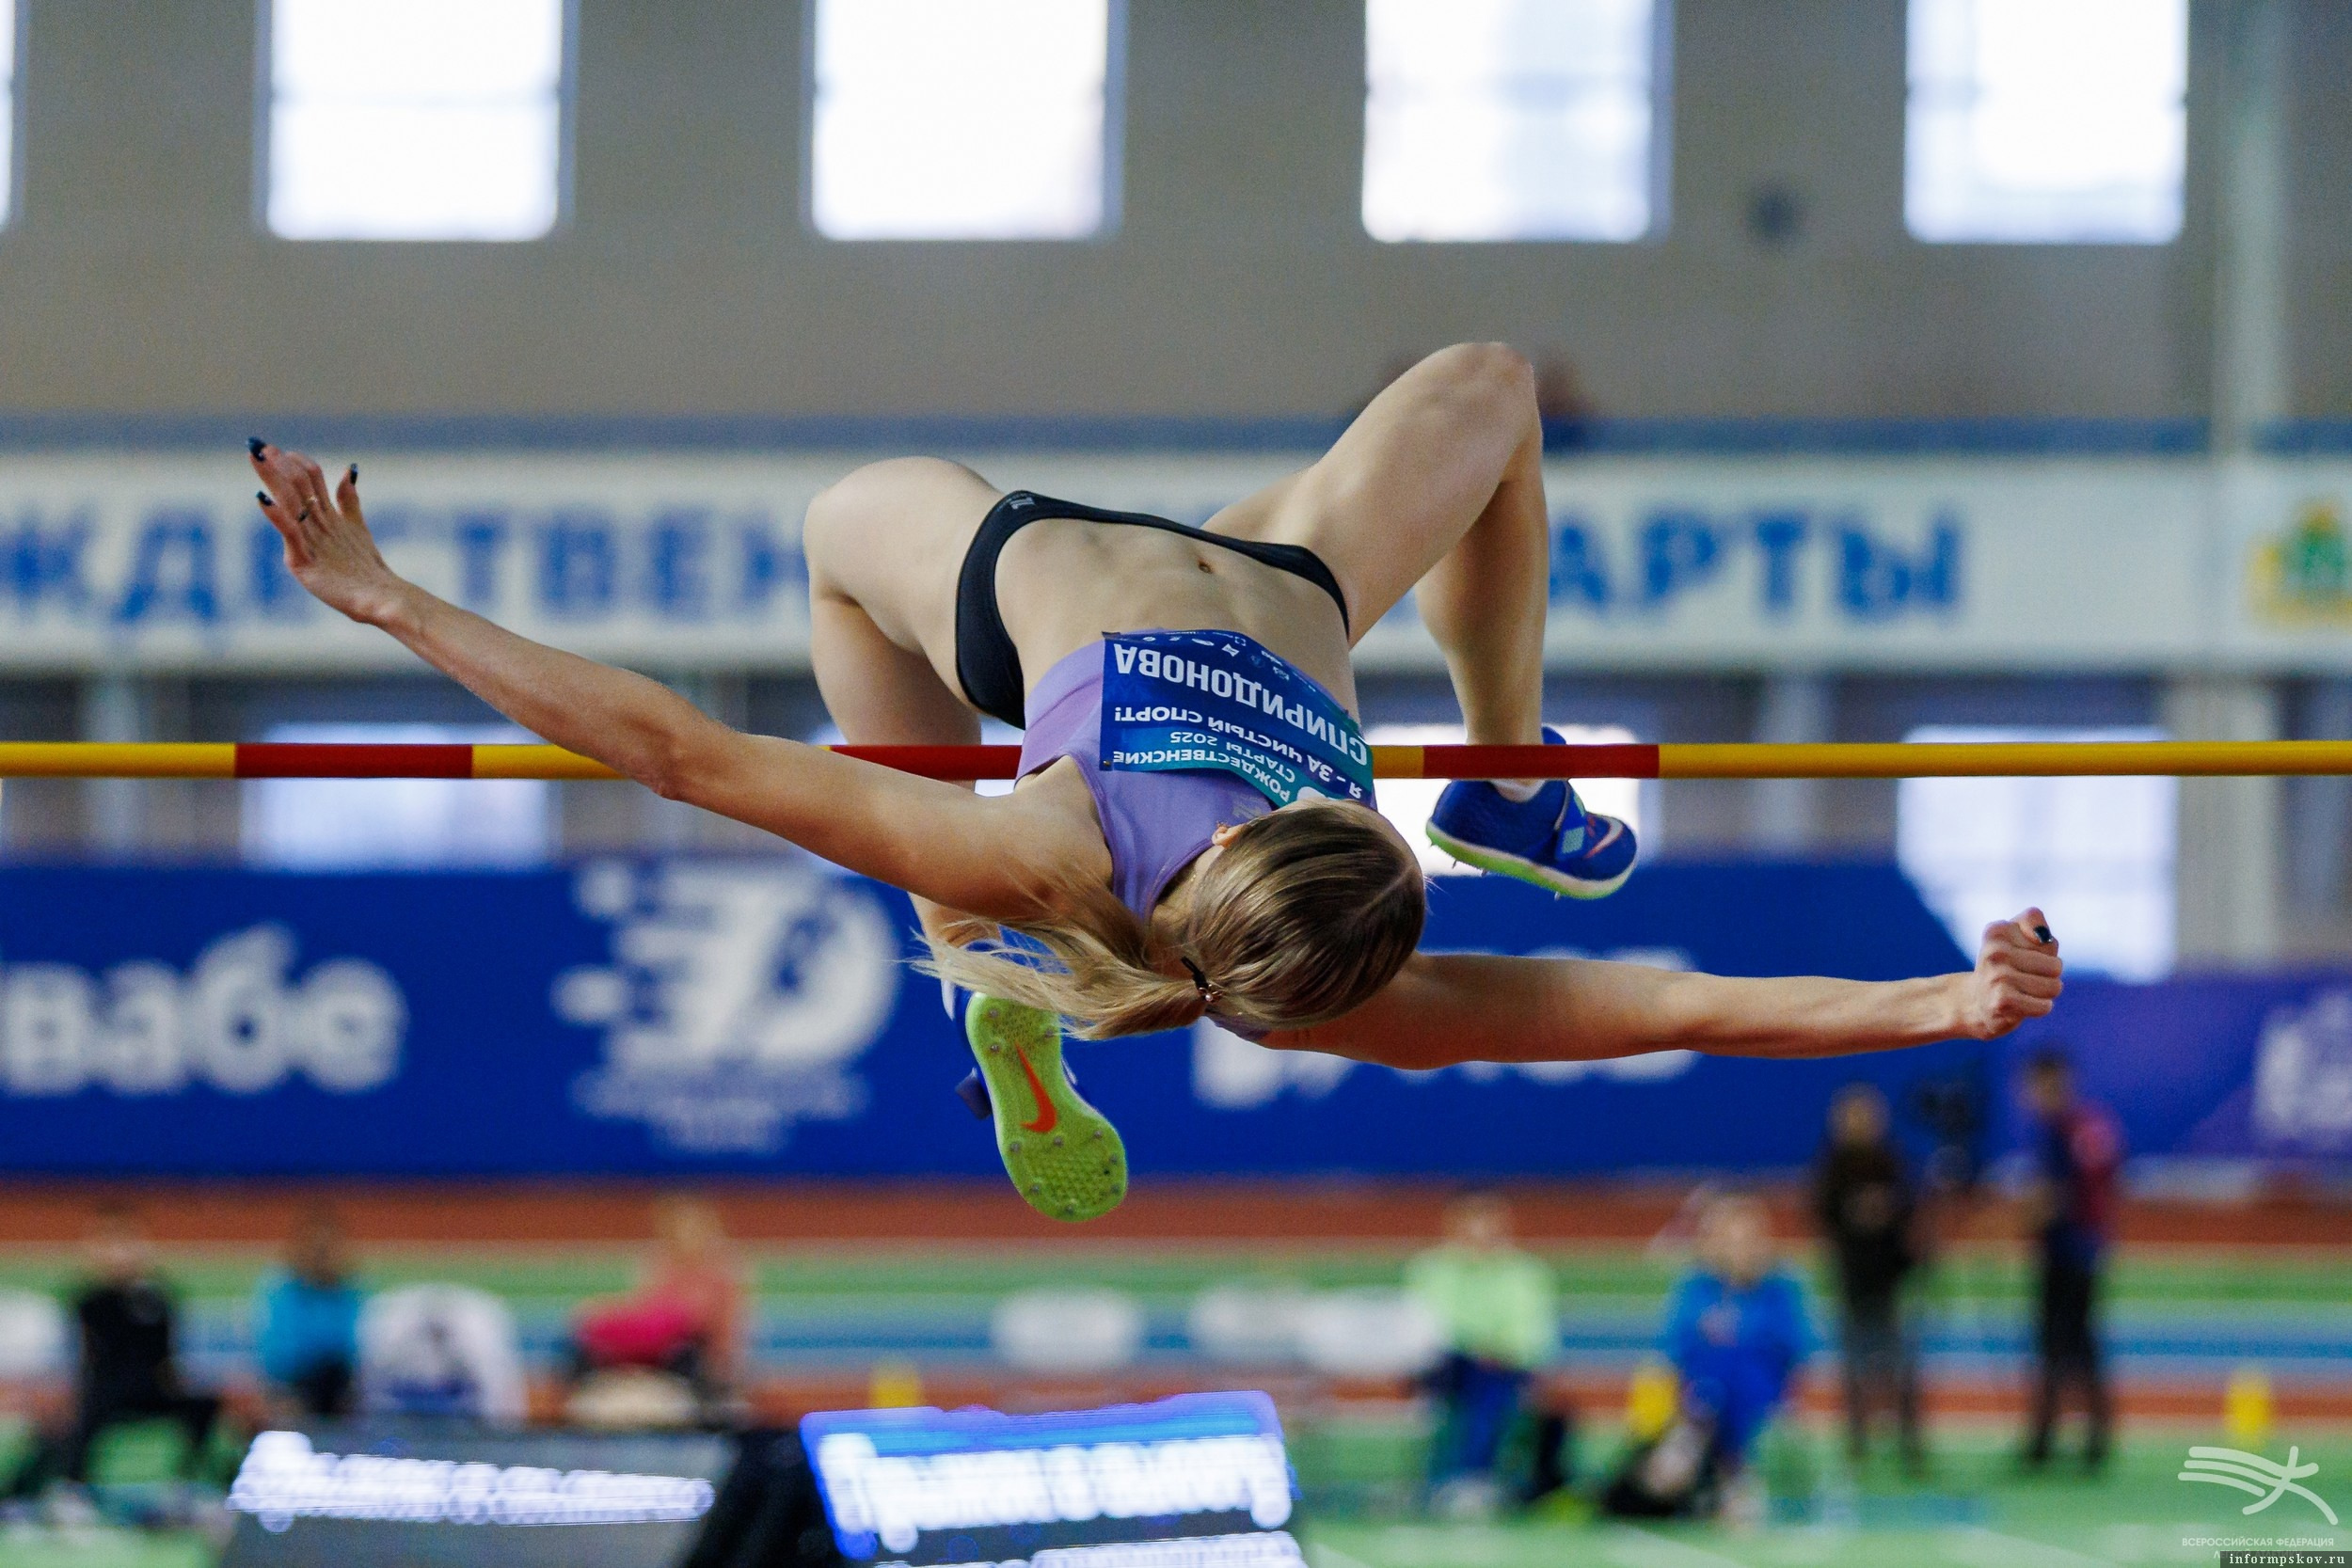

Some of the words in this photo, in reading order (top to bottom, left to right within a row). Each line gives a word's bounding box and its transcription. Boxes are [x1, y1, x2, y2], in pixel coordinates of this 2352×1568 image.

[1113, 643, 1367, 766] СПИРИДОНОВА
[1115, 706, 1203, 722] СПОРТ!
[1169, 732, 1217, 746] 2025
[1208, 717, 1302, 762] ЧИСТЫЙ
[1113, 751, 1291, 802] РОЖДЕСТВЕНСКИЕ
[1226, 741, 1295, 784] СТАРТЫ
[1307, 754, 1333, 782] ЗА
[1348, 782, 1363, 799] Я
